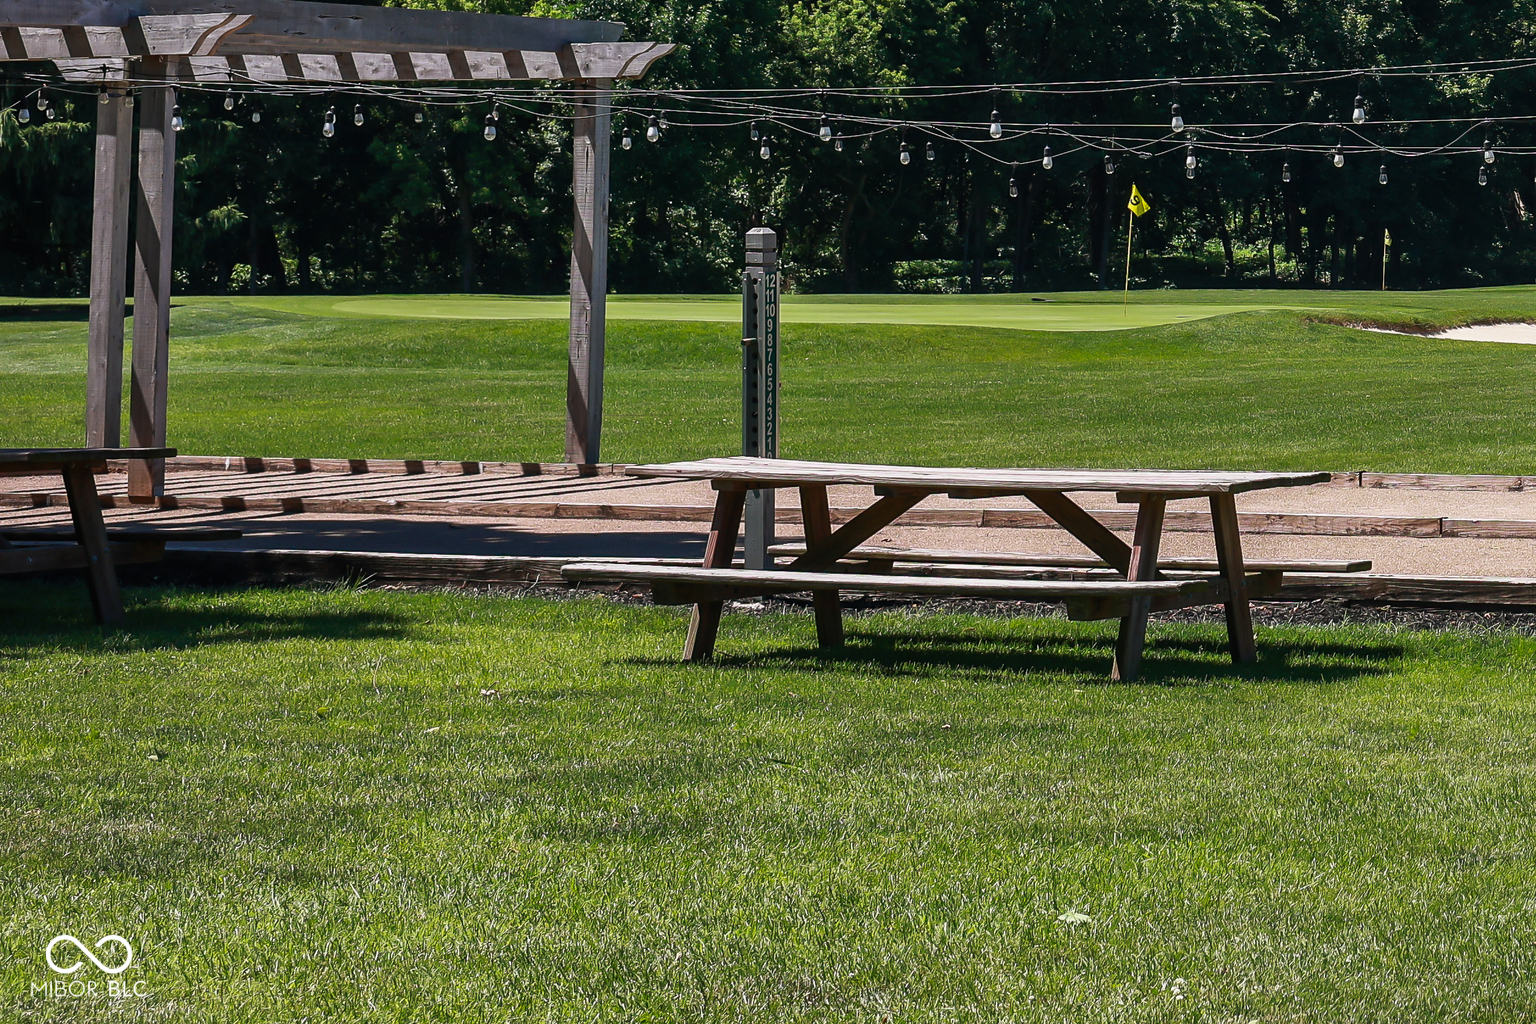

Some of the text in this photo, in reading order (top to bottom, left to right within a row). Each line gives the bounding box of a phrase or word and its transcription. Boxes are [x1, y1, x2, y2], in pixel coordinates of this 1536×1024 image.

[1130, 195, 1140, 206] 9
[765, 274, 776, 288] 12
[765, 289, 774, 302] 11
[765, 304, 776, 317] 10
[767, 319, 773, 332] 9
[767, 334, 773, 346] 8
[767, 348, 773, 361] 7
[767, 363, 773, 376] 6
[767, 378, 773, 391] 5
[767, 392, 773, 406] 4
[767, 407, 773, 420] 3
[767, 422, 773, 435] 2
[767, 437, 772, 450] 1
